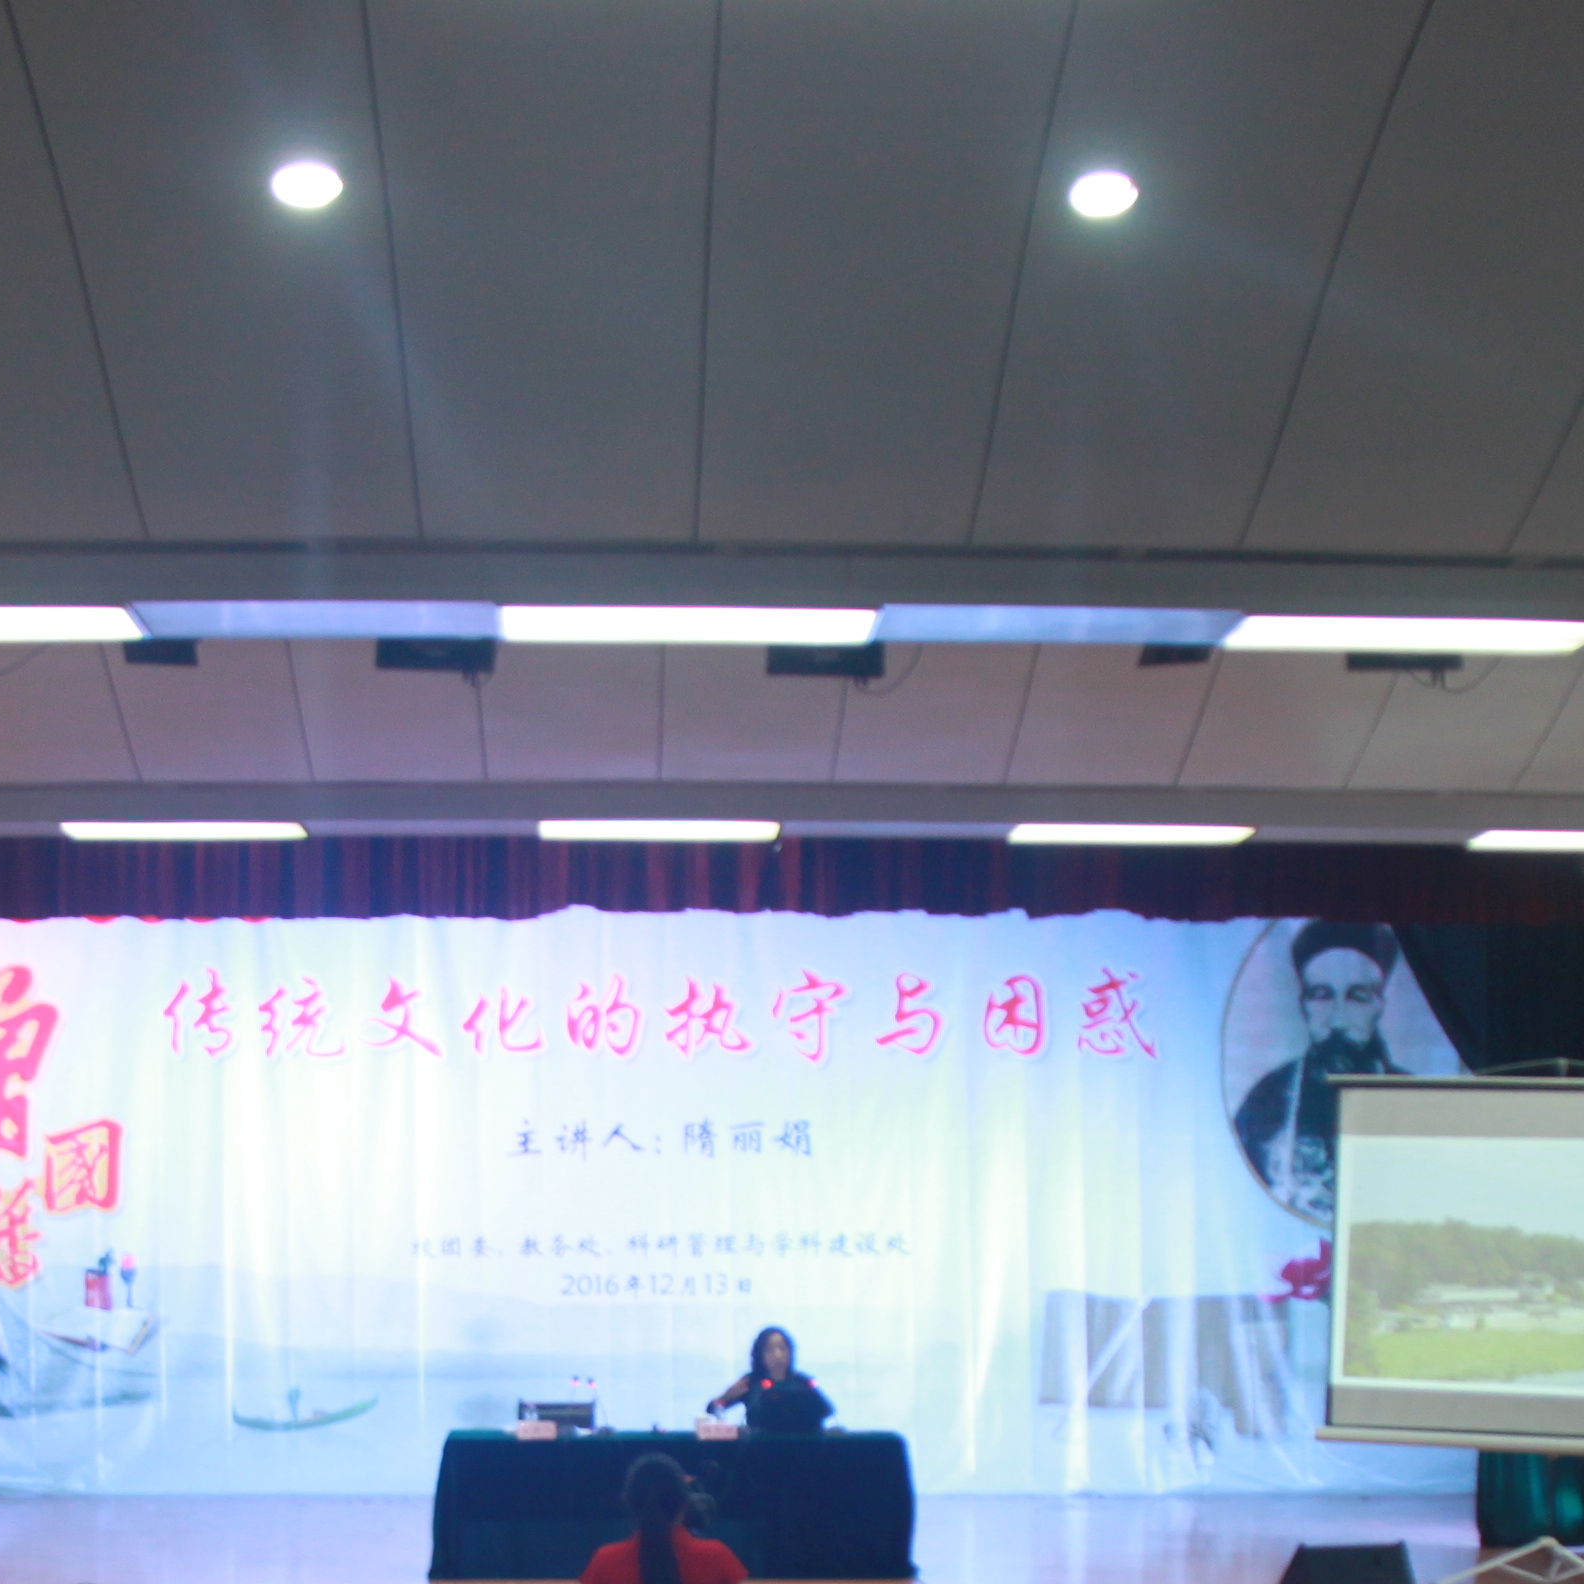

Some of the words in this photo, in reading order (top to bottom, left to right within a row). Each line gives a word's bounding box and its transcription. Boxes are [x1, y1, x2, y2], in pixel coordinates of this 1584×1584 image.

[163, 966, 1159, 1063] 传统文化的执守与困惑
[560, 1272, 753, 1299] 2016年12月13日
